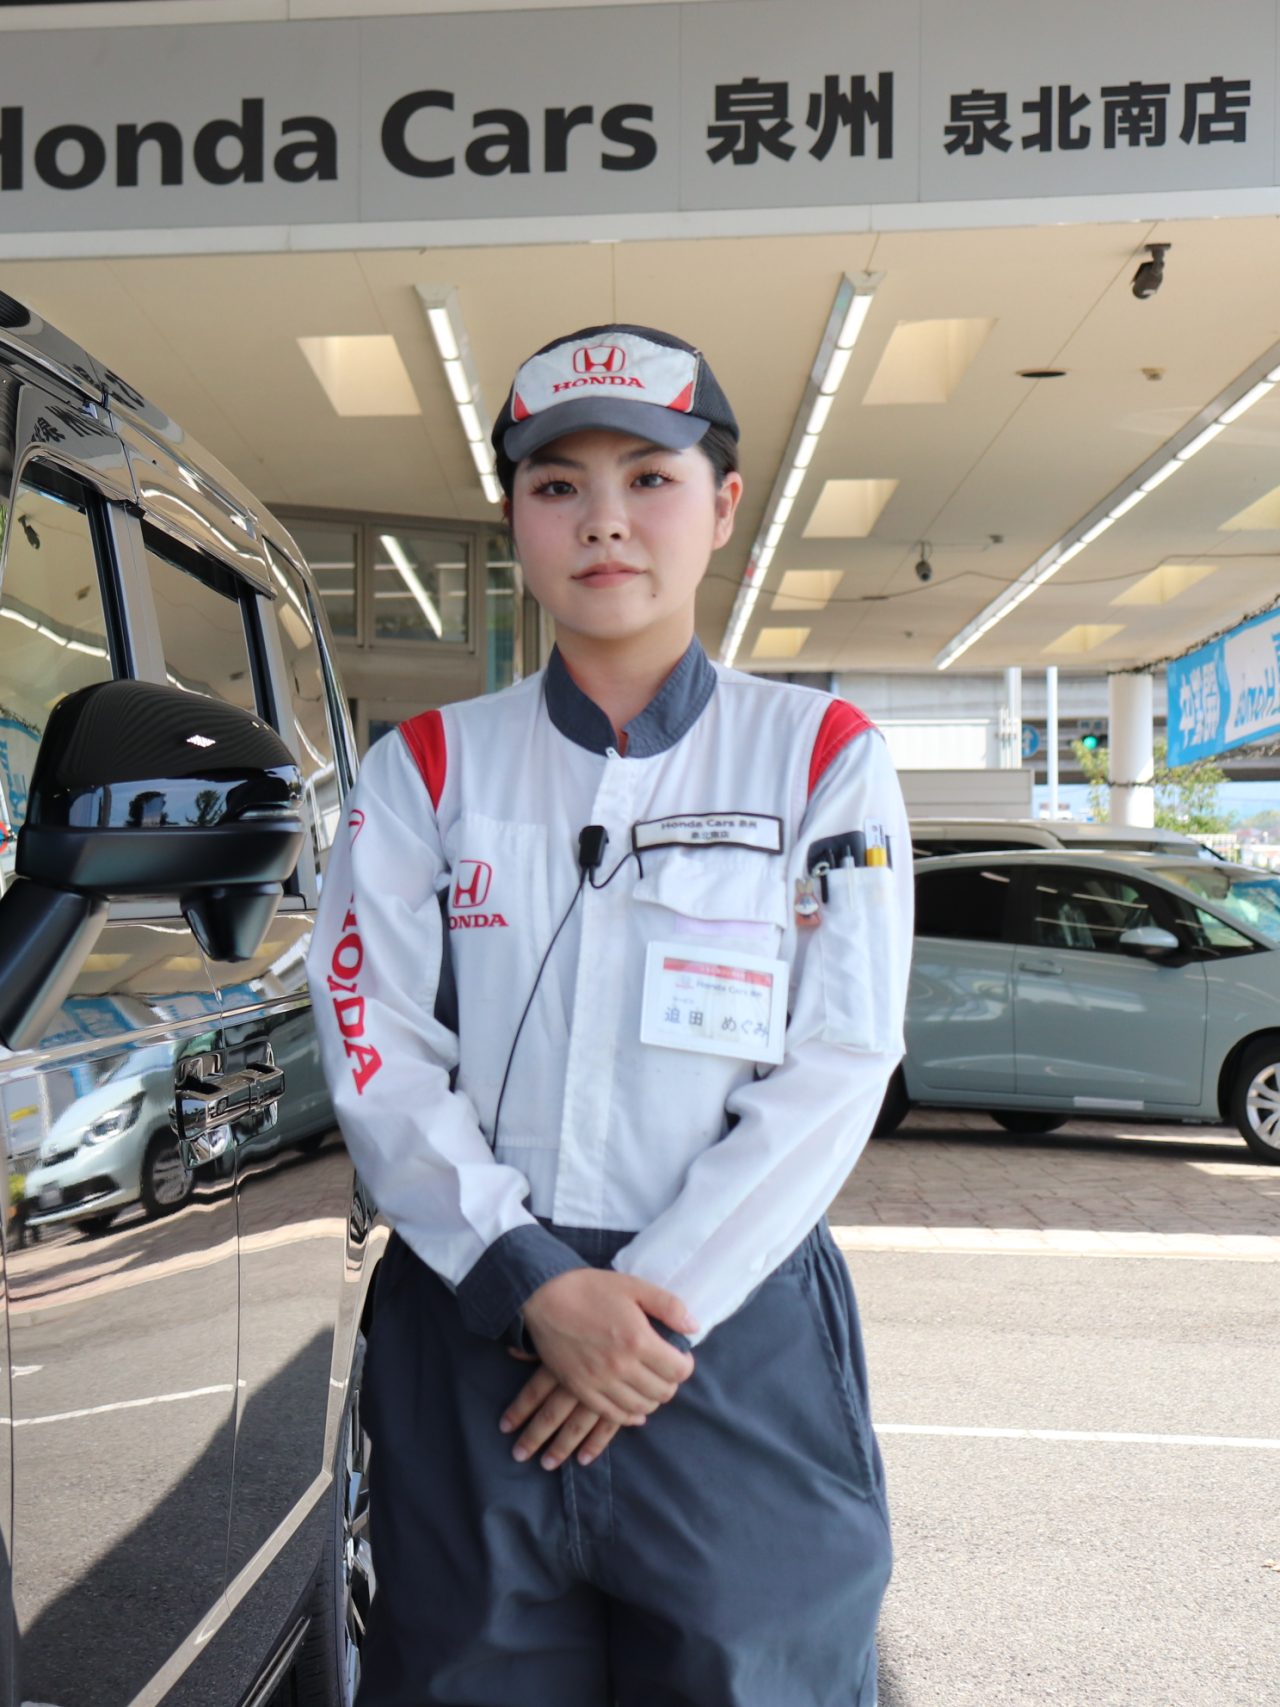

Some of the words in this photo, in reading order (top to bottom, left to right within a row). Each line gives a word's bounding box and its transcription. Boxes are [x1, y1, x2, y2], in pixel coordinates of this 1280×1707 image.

[380, 89, 658, 178] Cars
[706, 71, 894, 165] 泉州
[943, 76, 1251, 155] 泉北南店
[551, 376, 646, 394] HONDA
[660, 820, 703, 831] Honda
[706, 819, 735, 829] Cars
[448, 913, 510, 931] ONDA
